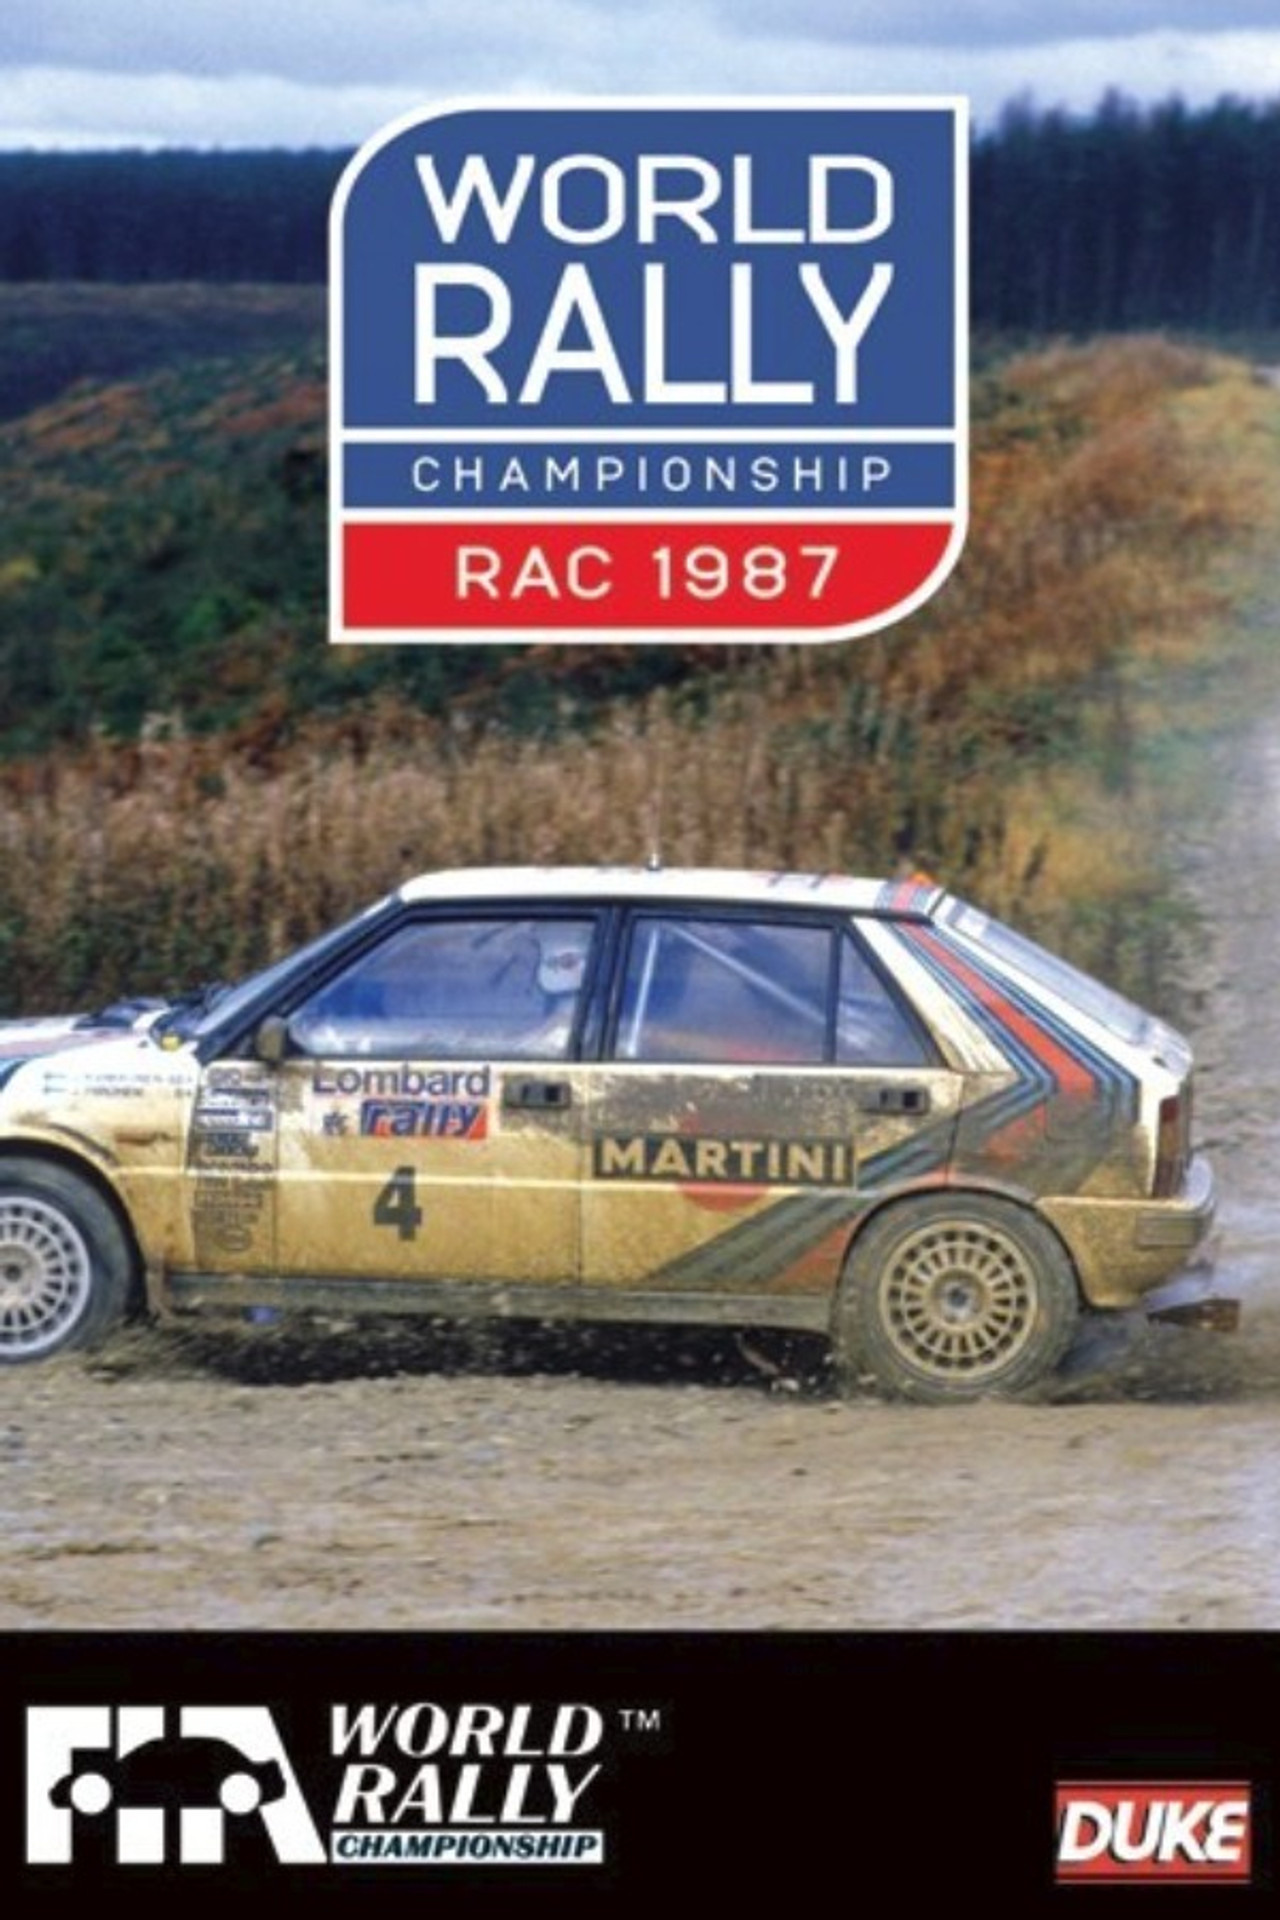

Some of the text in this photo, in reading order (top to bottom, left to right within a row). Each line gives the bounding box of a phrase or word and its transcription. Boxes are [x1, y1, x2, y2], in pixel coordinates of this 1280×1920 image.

[313, 1062, 490, 1096] Lombard
[362, 1100, 482, 1137] rally
[602, 1137, 845, 1181] MARTINI
[373, 1165, 422, 1241] 4
